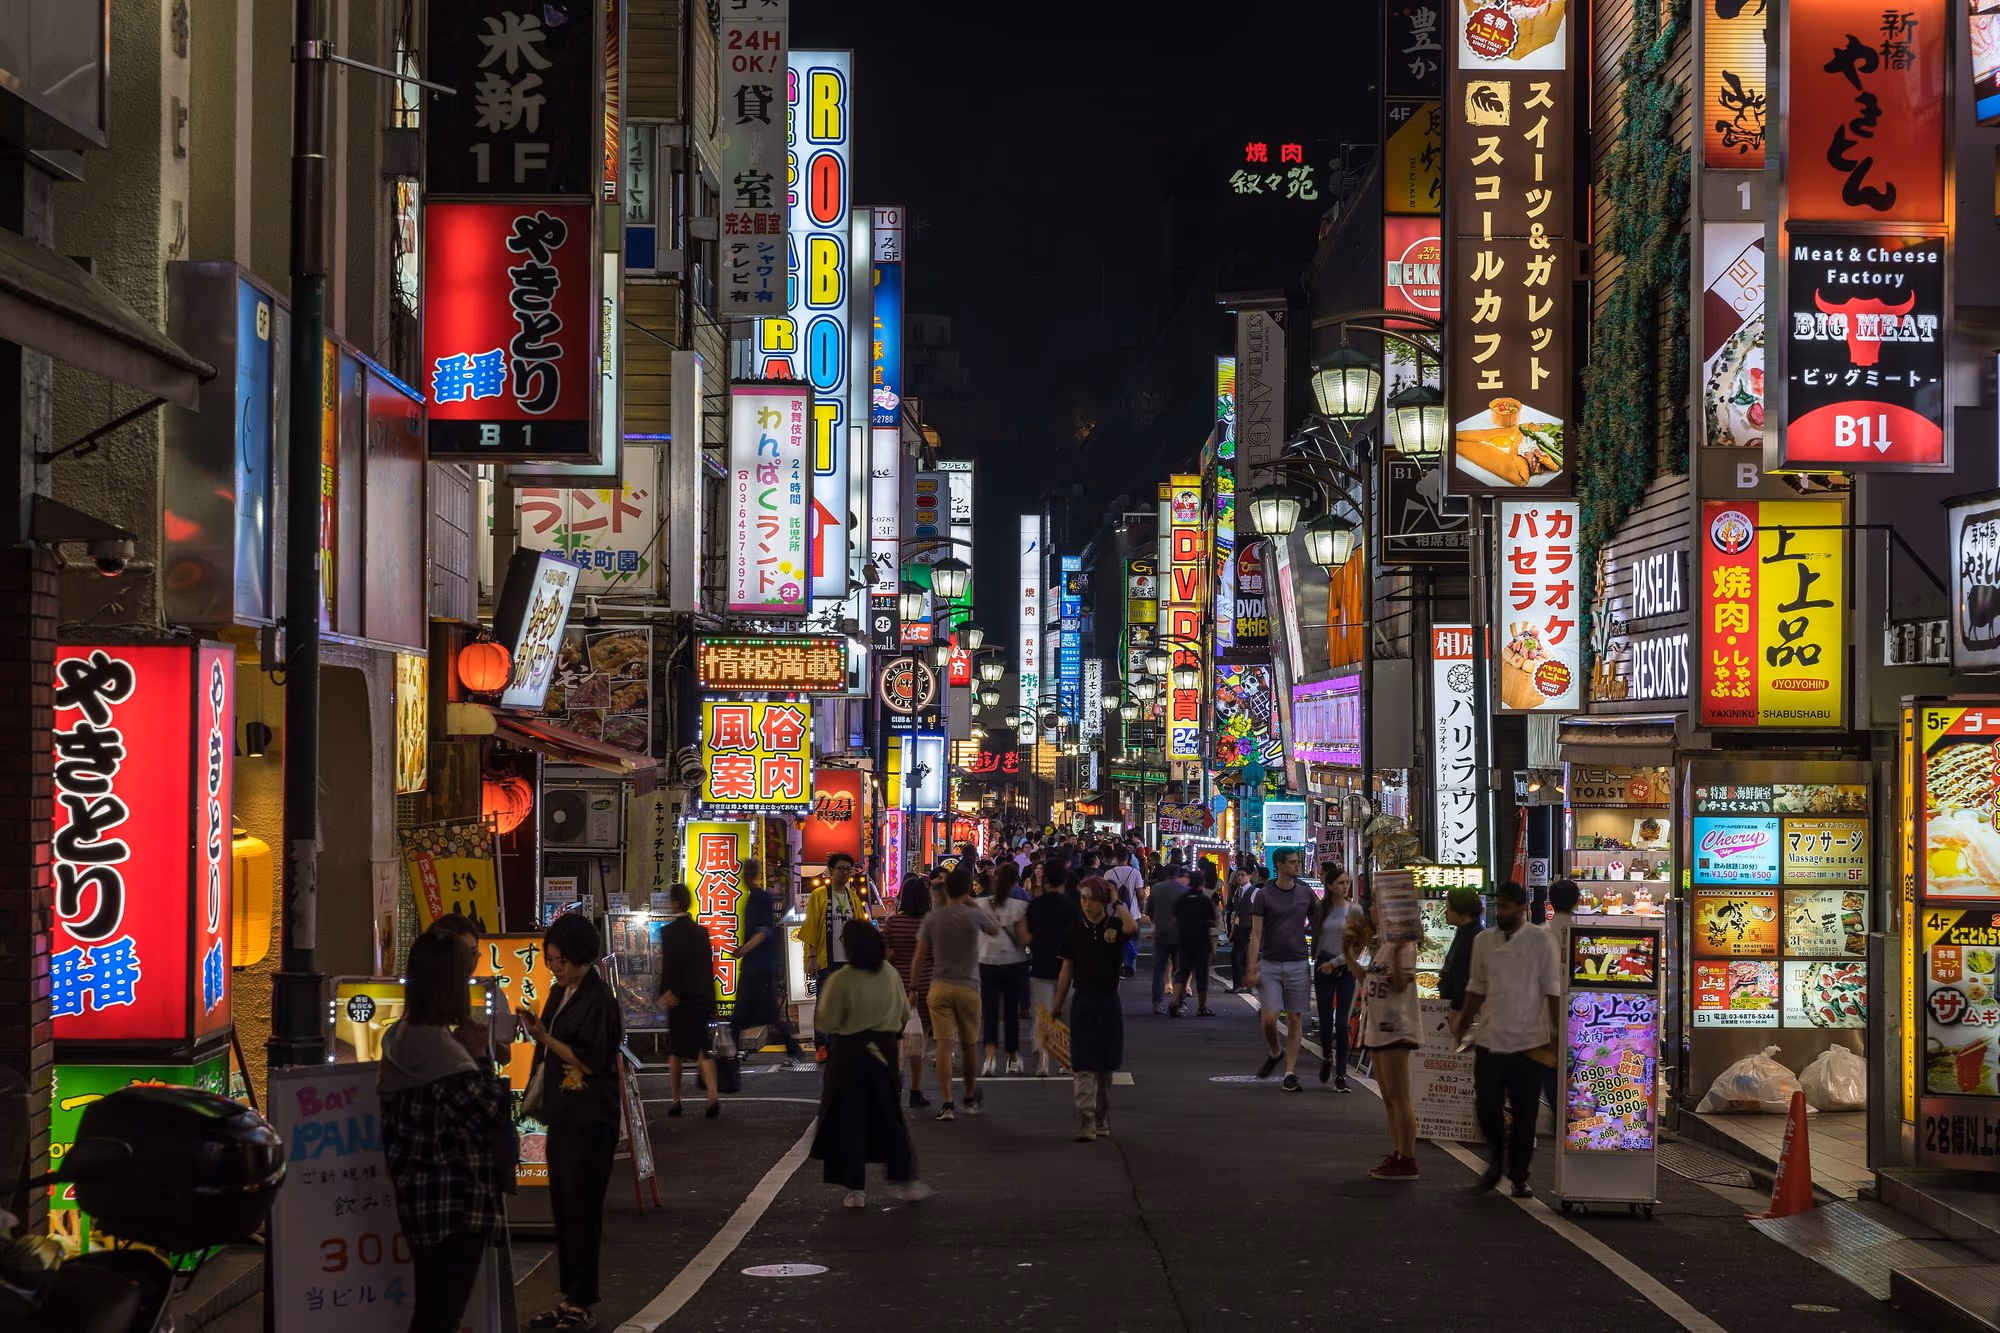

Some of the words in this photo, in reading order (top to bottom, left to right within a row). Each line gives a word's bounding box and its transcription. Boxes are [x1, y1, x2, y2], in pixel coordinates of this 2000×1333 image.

[1483, 13, 1508, 30] 名物
[728, 30, 781, 50] 24H
[1469, 22, 1510, 47] ハニトー
[1471, 34, 1487, 45] HONEY
[1487, 39, 1503, 49] TOAST
[1472, 40, 1486, 49] SINCE
[1880, 10, 1919, 72] 新橋
[731, 55, 777, 73] OK!
[1389, 107, 1410, 120] 4F
[1824, 34, 1896, 211] やきとん
[1246, 142, 1303, 163] 焼肉
[467, 142, 552, 184] 1F
[1228, 166, 1319, 200] 叙々苑
[725, 213, 781, 235] 完全個室
[1523, 81, 1555, 391] スイーツ&ガレット
[884, 251, 899, 261] 5F
[1470, 136, 1505, 390] スコールカフェ
[1795, 246, 1843, 262] Meat
[1850, 247, 1861, 262] &
[1867, 246, 1938, 264] Cheese
[731, 241, 749, 303] テレビ有
[755, 241, 775, 303] シャワー有
[807, 69, 845, 475] ROBOT
[1827, 270, 1905, 288] Factory
[506, 211, 567, 415] やきとり
[1274, 312, 1284, 322] 2F
[1794, 312, 1848, 341] BIG
[1856, 314, 1938, 342] MEAT
[790, 400, 803, 447] 歌舞伎町
[1835, 415, 1870, 447] B1
[479, 425, 533, 447] B1
[789, 459, 802, 505] 24時間
[1394, 472, 1413, 480] B1
[756, 406, 782, 595] わんぱくランド
[738, 482, 746, 600] 03-6457-3978
[789, 517, 801, 552] 託児所
[879, 527, 895, 535] 3F
[1508, 509, 1539, 611] パセラ
[880, 582, 895, 590] 2F
[1545, 509, 1575, 646] カラオケ
[1632, 550, 1681, 619] PASELA
[782, 587, 799, 598] 2F
[1025, 587, 1035, 616] 焼肉
[1762, 525, 1834, 668] 上上品
[876, 619, 891, 630] 2F
[901, 626, 929, 641] たばこ
[870, 637, 896, 650] walk
[1026, 638, 1035, 666] 叙々苑
[704, 647, 841, 681] 情報満載
[1632, 633, 1690, 700] RESORTS
[1711, 650, 1730, 698] しゃぶ
[1732, 650, 1751, 698] しゃぶ
[1538, 670, 1568, 684] ハニトー
[1774, 679, 1826, 689] JYOJYOHIN
[1541, 685, 1558, 693] TOAST
[928, 715, 936, 723] B1
[1710, 709, 1755, 718] YAKINIKU
[1763, 710, 1831, 719] SHABUSHABU
[1927, 712, 1950, 730] 5F
[709, 705, 806, 752] 風俗
[1173, 728, 1197, 746] 24
[711, 753, 804, 800] 案内
[1574, 769, 1632, 785] ハニトー
[53, 650, 136, 942] やきとり
[208, 657, 225, 933] やきとり
[1574, 787, 1625, 798] TOAST
[1160, 819, 1181, 831] 受付
[1701, 830, 1765, 851] Cheerup
[1788, 832, 1863, 852] マッサージ
[1789, 854, 1823, 865] Massage
[1405, 866, 1483, 888] 営業時間
[1848, 869, 1862, 880] 5F
[1927, 914, 1950, 931] 4F
[1937, 950, 1956, 958] 各種
[1938, 970, 1955, 978] 有り
[353, 1010, 370, 1022] 3F
[1584, 994, 1651, 1028] 上上品
[1576, 1030, 1603, 1043] 焼肉
[1622, 1051, 1644, 1065] 食べ
[1573, 1066, 1613, 1084] 1890円
[1619, 1062, 1643, 1077] 放題
[1589, 1077, 1629, 1095] 2980円
[297, 1087, 359, 1116] Bar
[1599, 1089, 1639, 1106] 3980円
[1608, 1101, 1648, 1118] 4980円
